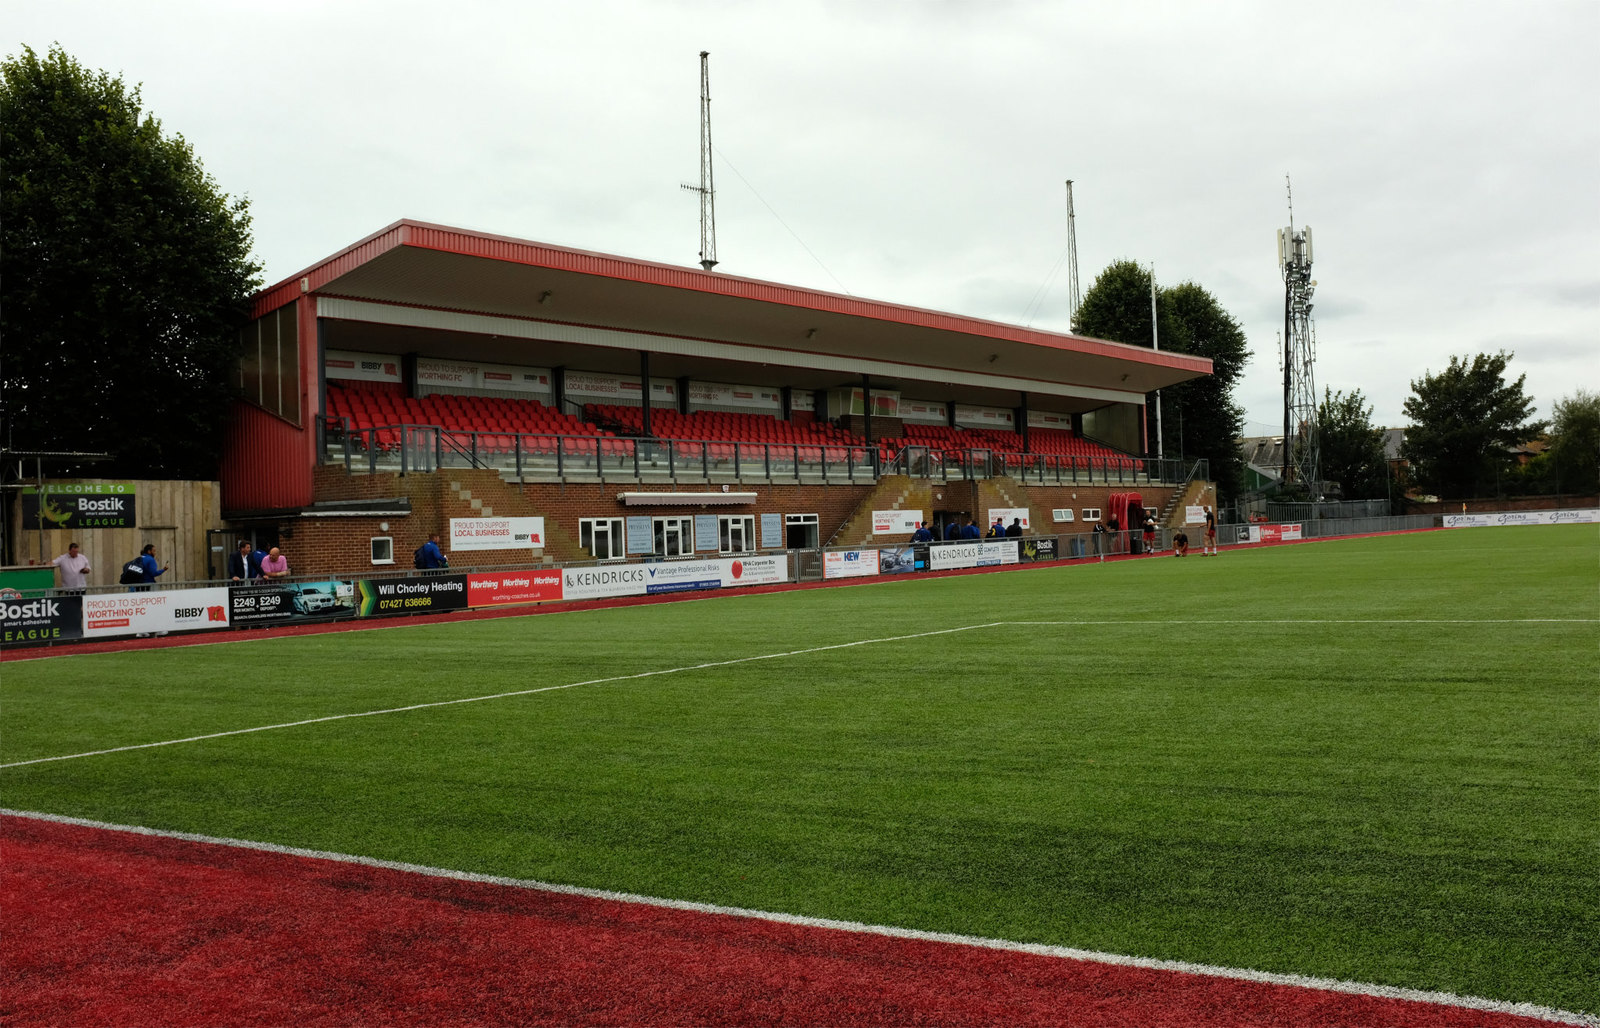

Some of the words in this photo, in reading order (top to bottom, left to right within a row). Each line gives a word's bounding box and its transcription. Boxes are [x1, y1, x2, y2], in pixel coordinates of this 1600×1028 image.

[362, 362, 382, 370] BIBBY
[418, 362, 440, 372] PROUD
[441, 364, 449, 372] TO
[450, 365, 478, 374] SUPPORT
[418, 372, 453, 380] WORTHING
[584, 384, 618, 392] BUSINESSES
[109, 485, 125, 493] TO
[78, 497, 124, 510] Bostik
[1448, 516, 1475, 526] Gorng
[1037, 540, 1053, 549] Bostik
[938, 548, 975, 560] KENDRICKS
[678, 564, 707, 573] Professional
[503, 579, 529, 587] Worthing
[534, 577, 560, 586] Worthing
[577, 571, 644, 586] KENDRICKS
[379, 584, 394, 595] Will
[397, 582, 429, 594] Chorley
[432, 581, 463, 592] Heating
[470, 580, 498, 589] Worthing
[493, 592, 541, 601] worthing-coaches.co.uk
[88, 600, 116, 609] PROUD
[131, 597, 167, 606] SUPPORT
[234, 597, 255, 608] £249
[260, 596, 281, 606] £249
[380, 599, 403, 609] 07427
[404, 597, 432, 607] 636666
[0, 599, 60, 620] Bostik
[88, 609, 133, 618] WORTHING
[175, 607, 204, 618] BIBBY
[0, 628, 61, 641] EAGUE
